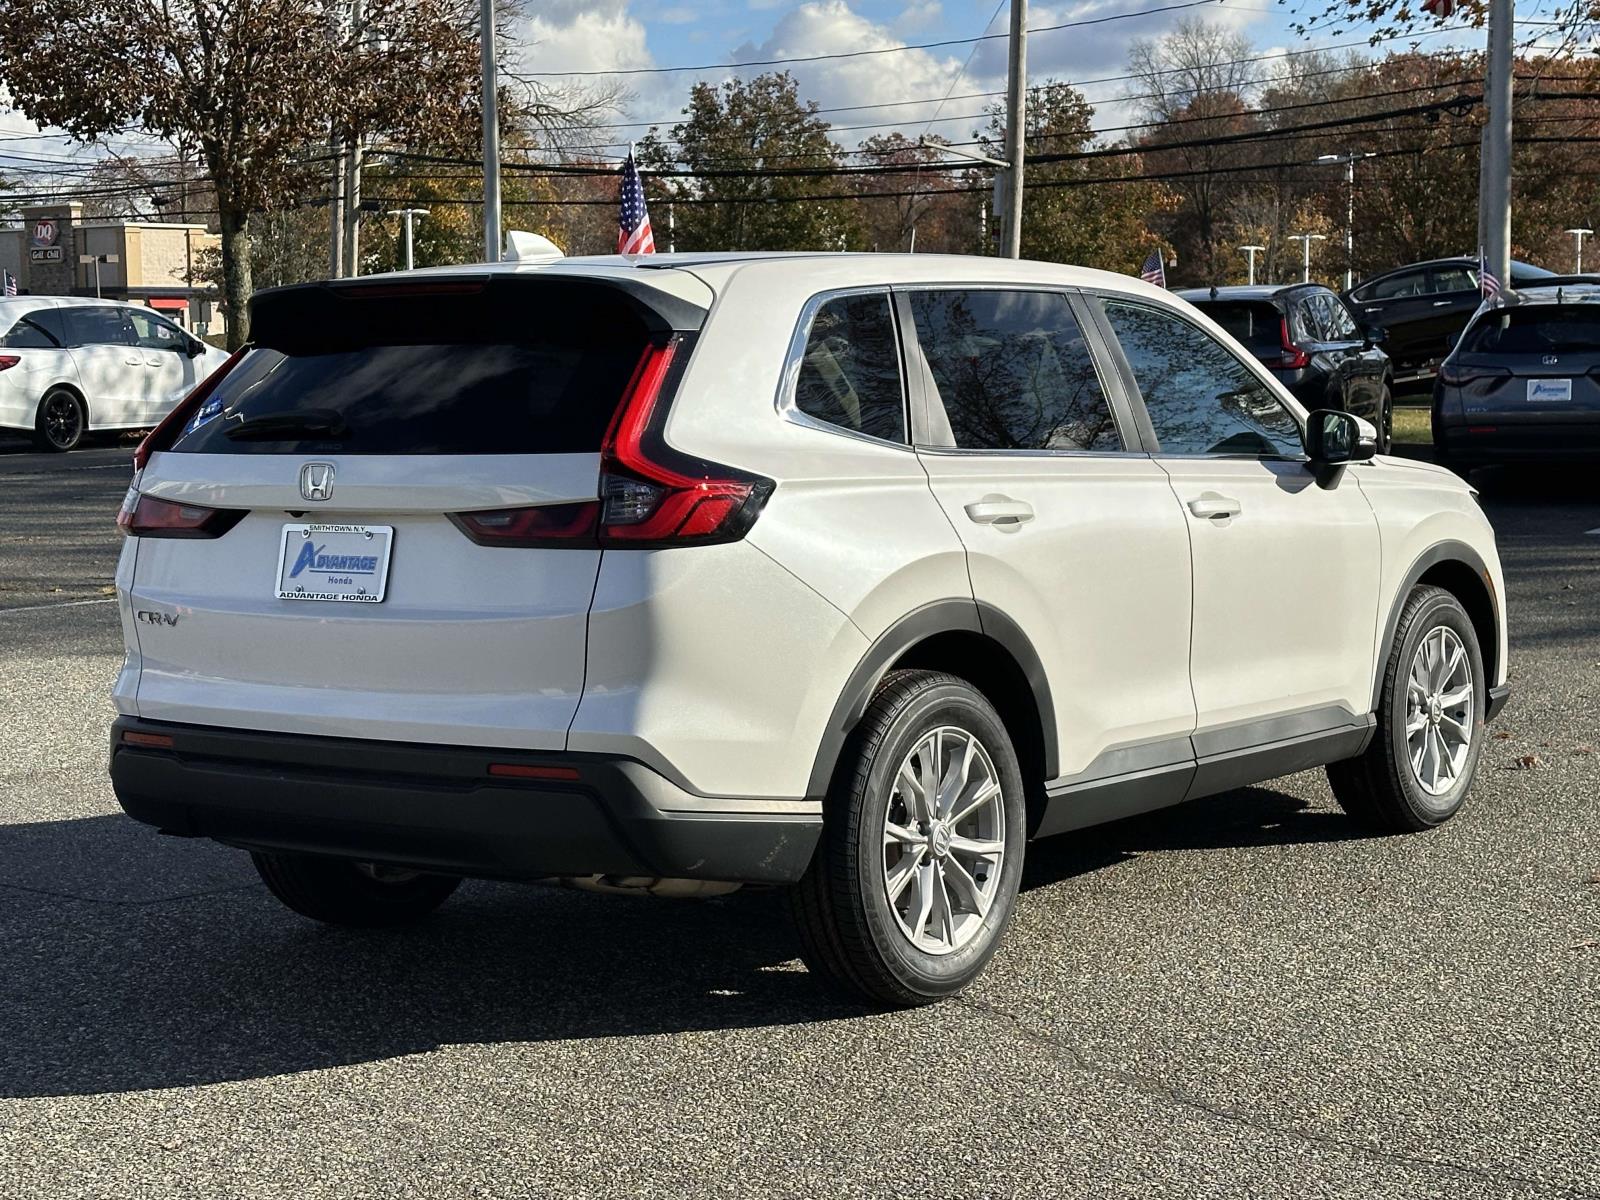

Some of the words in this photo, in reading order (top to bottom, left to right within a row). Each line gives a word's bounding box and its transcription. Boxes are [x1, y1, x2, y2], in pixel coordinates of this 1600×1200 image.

[37, 224, 52, 240] DQ
[288, 541, 378, 578] ADVANTAGE
[328, 576, 353, 585] Honda
[279, 592, 340, 600] ADVANTAGE
[341, 594, 378, 602] HONDA
